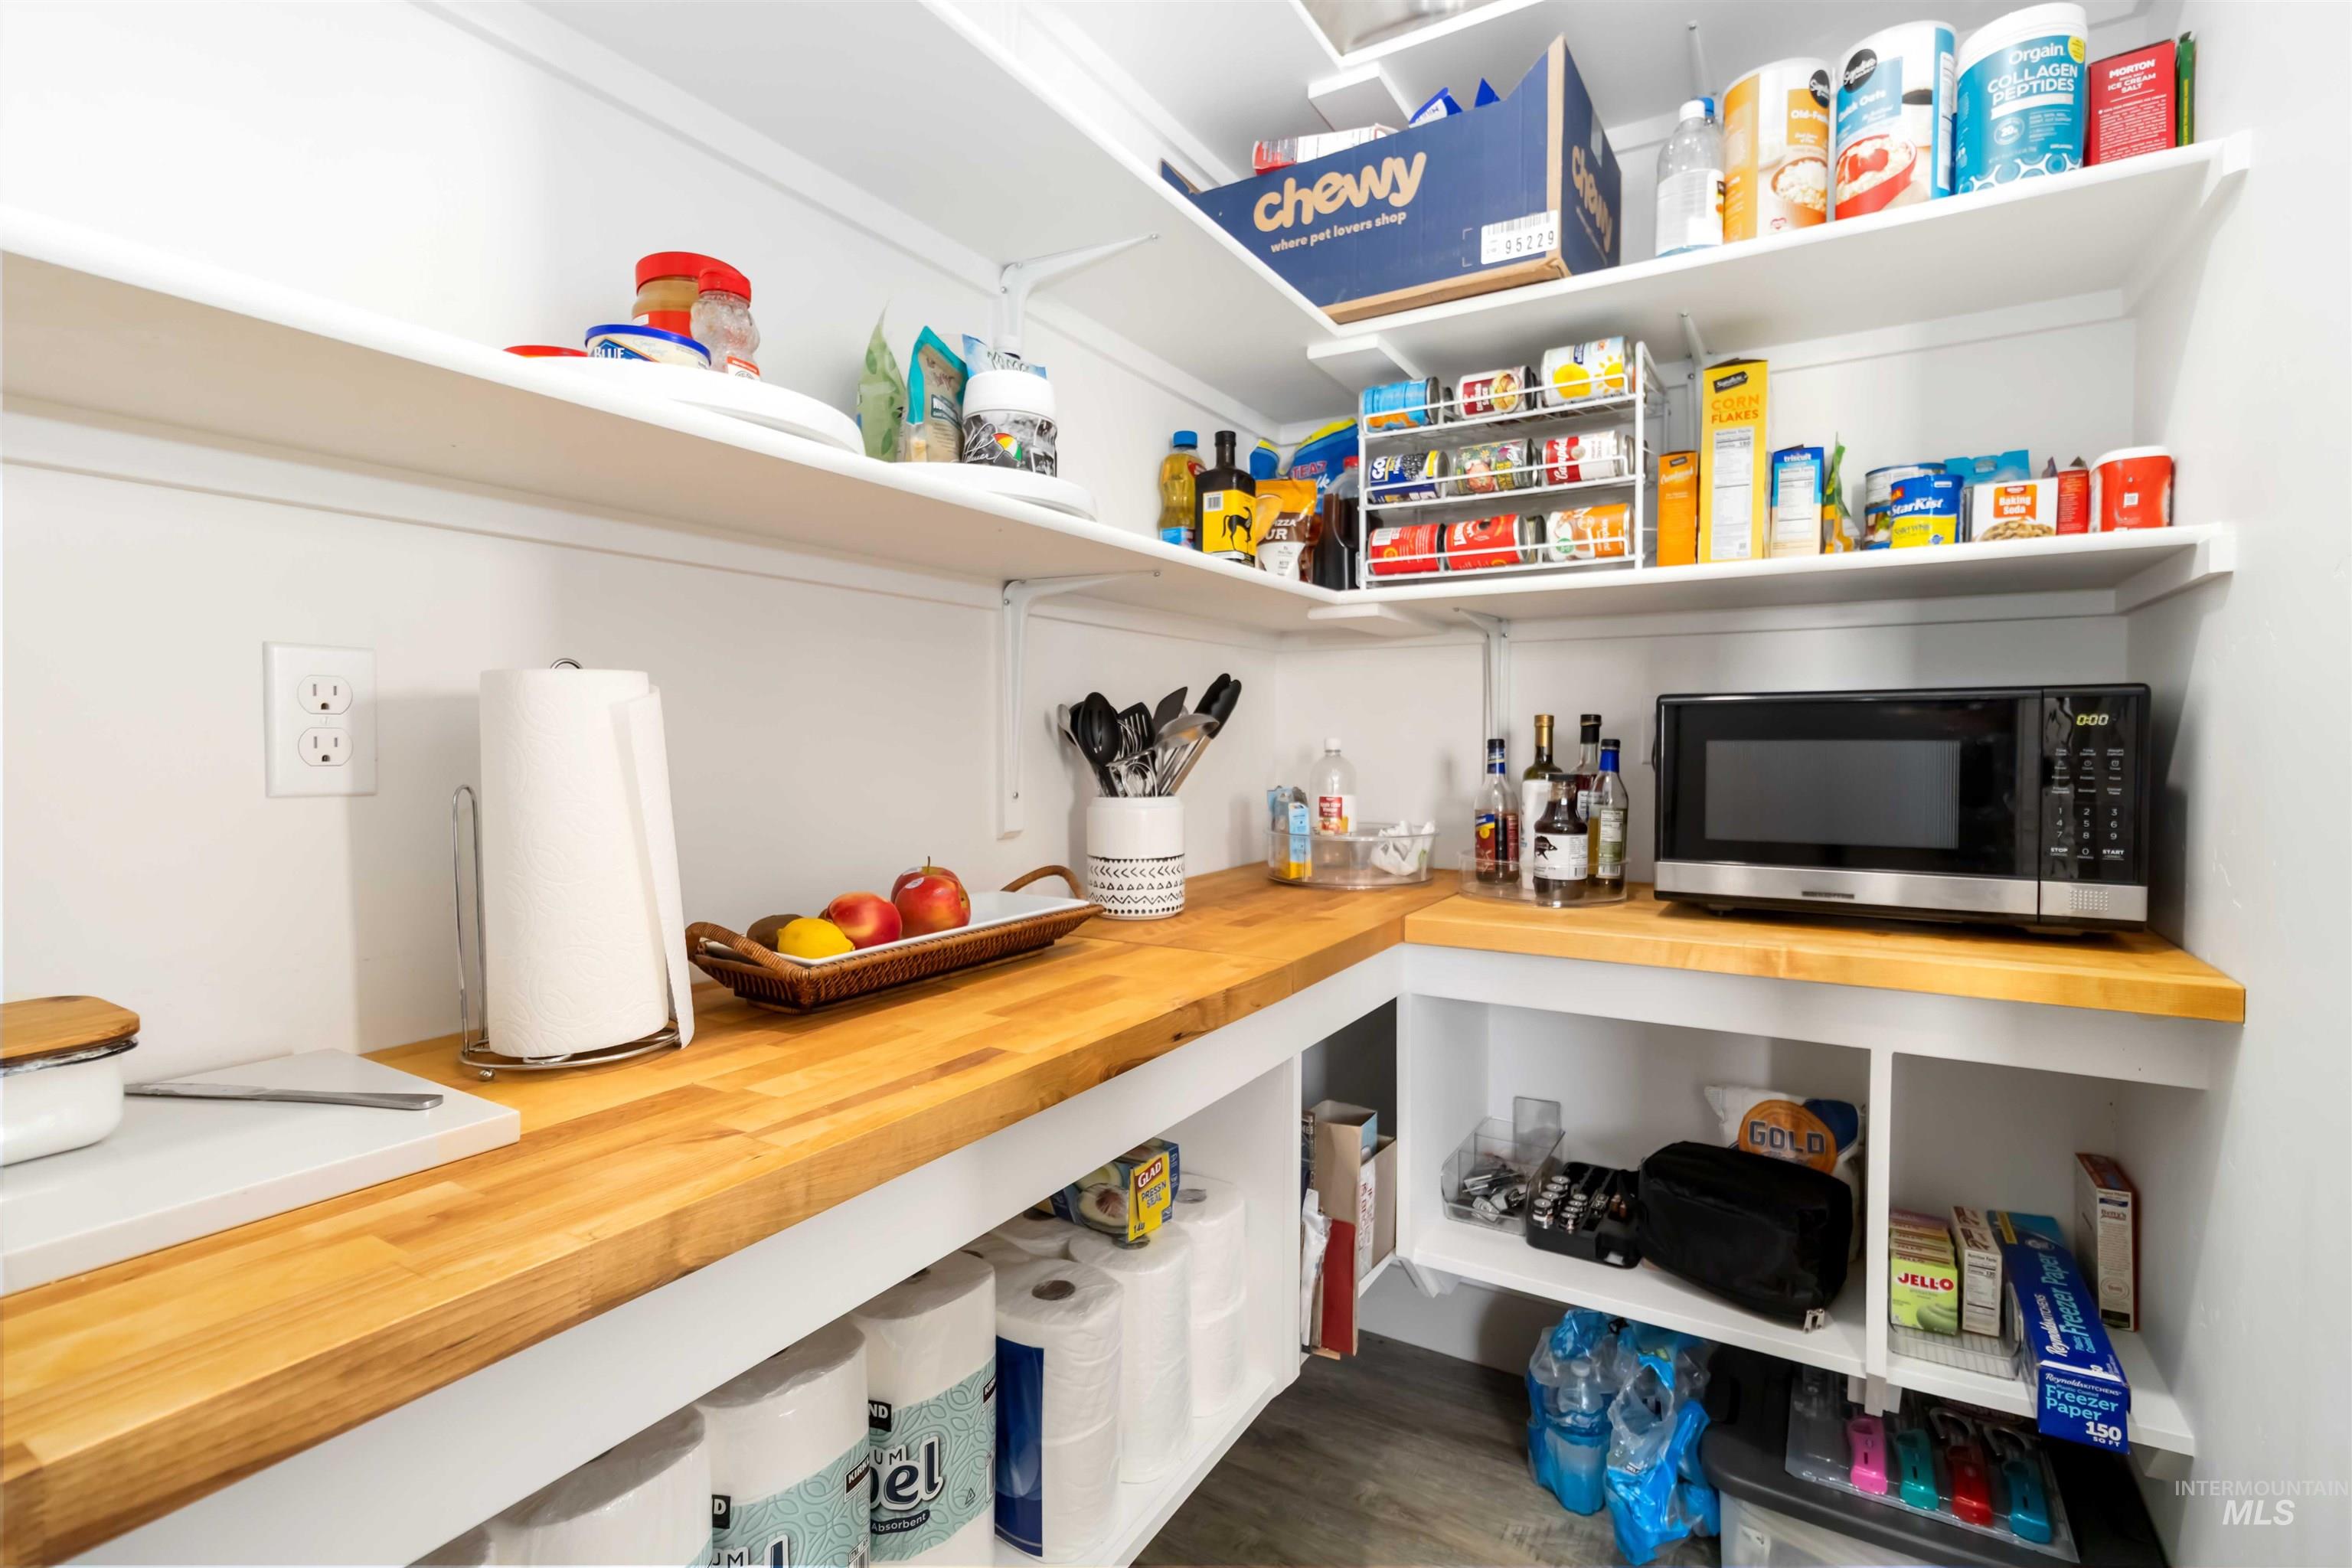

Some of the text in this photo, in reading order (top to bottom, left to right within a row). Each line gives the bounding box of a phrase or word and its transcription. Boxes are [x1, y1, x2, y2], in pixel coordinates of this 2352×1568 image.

[2008, 43, 2063, 64] Orgain
[1987, 63, 2078, 93] COLLAGEN
[2109, 58, 2157, 79] MORTON
[1992, 77, 2075, 106] PEPTIDES
[2108, 81, 2122, 91] ICE
[2124, 73, 2156, 87] CREAM
[2121, 83, 2143, 93] SALT
[1859, 90, 1887, 106] Oats
[1253, 151, 1427, 232] chewy
[1572, 145, 1613, 254] chewy
[1270, 211, 1407, 253] where pet lovers shop
[1711, 394, 1759, 410] CORN
[1711, 409, 1759, 424] FLAKES
[1892, 497, 1944, 514] StarKist
[1999, 496, 2032, 506] Baking
[2003, 506, 2027, 515] Soda
[2076, 714, 2109, 726] 0:00
[1749, 1120, 1825, 1154] GOLD
[1138, 1161, 1162, 1188] GLAD
[2038, 1253, 2089, 1337] Freezer Paper
[2046, 1384, 2119, 1412] Freezer
[2046, 1396, 2102, 1421] Paper
[2086, 1421, 2122, 1441] 150
[871, 1511, 926, 1532] Absorbent
